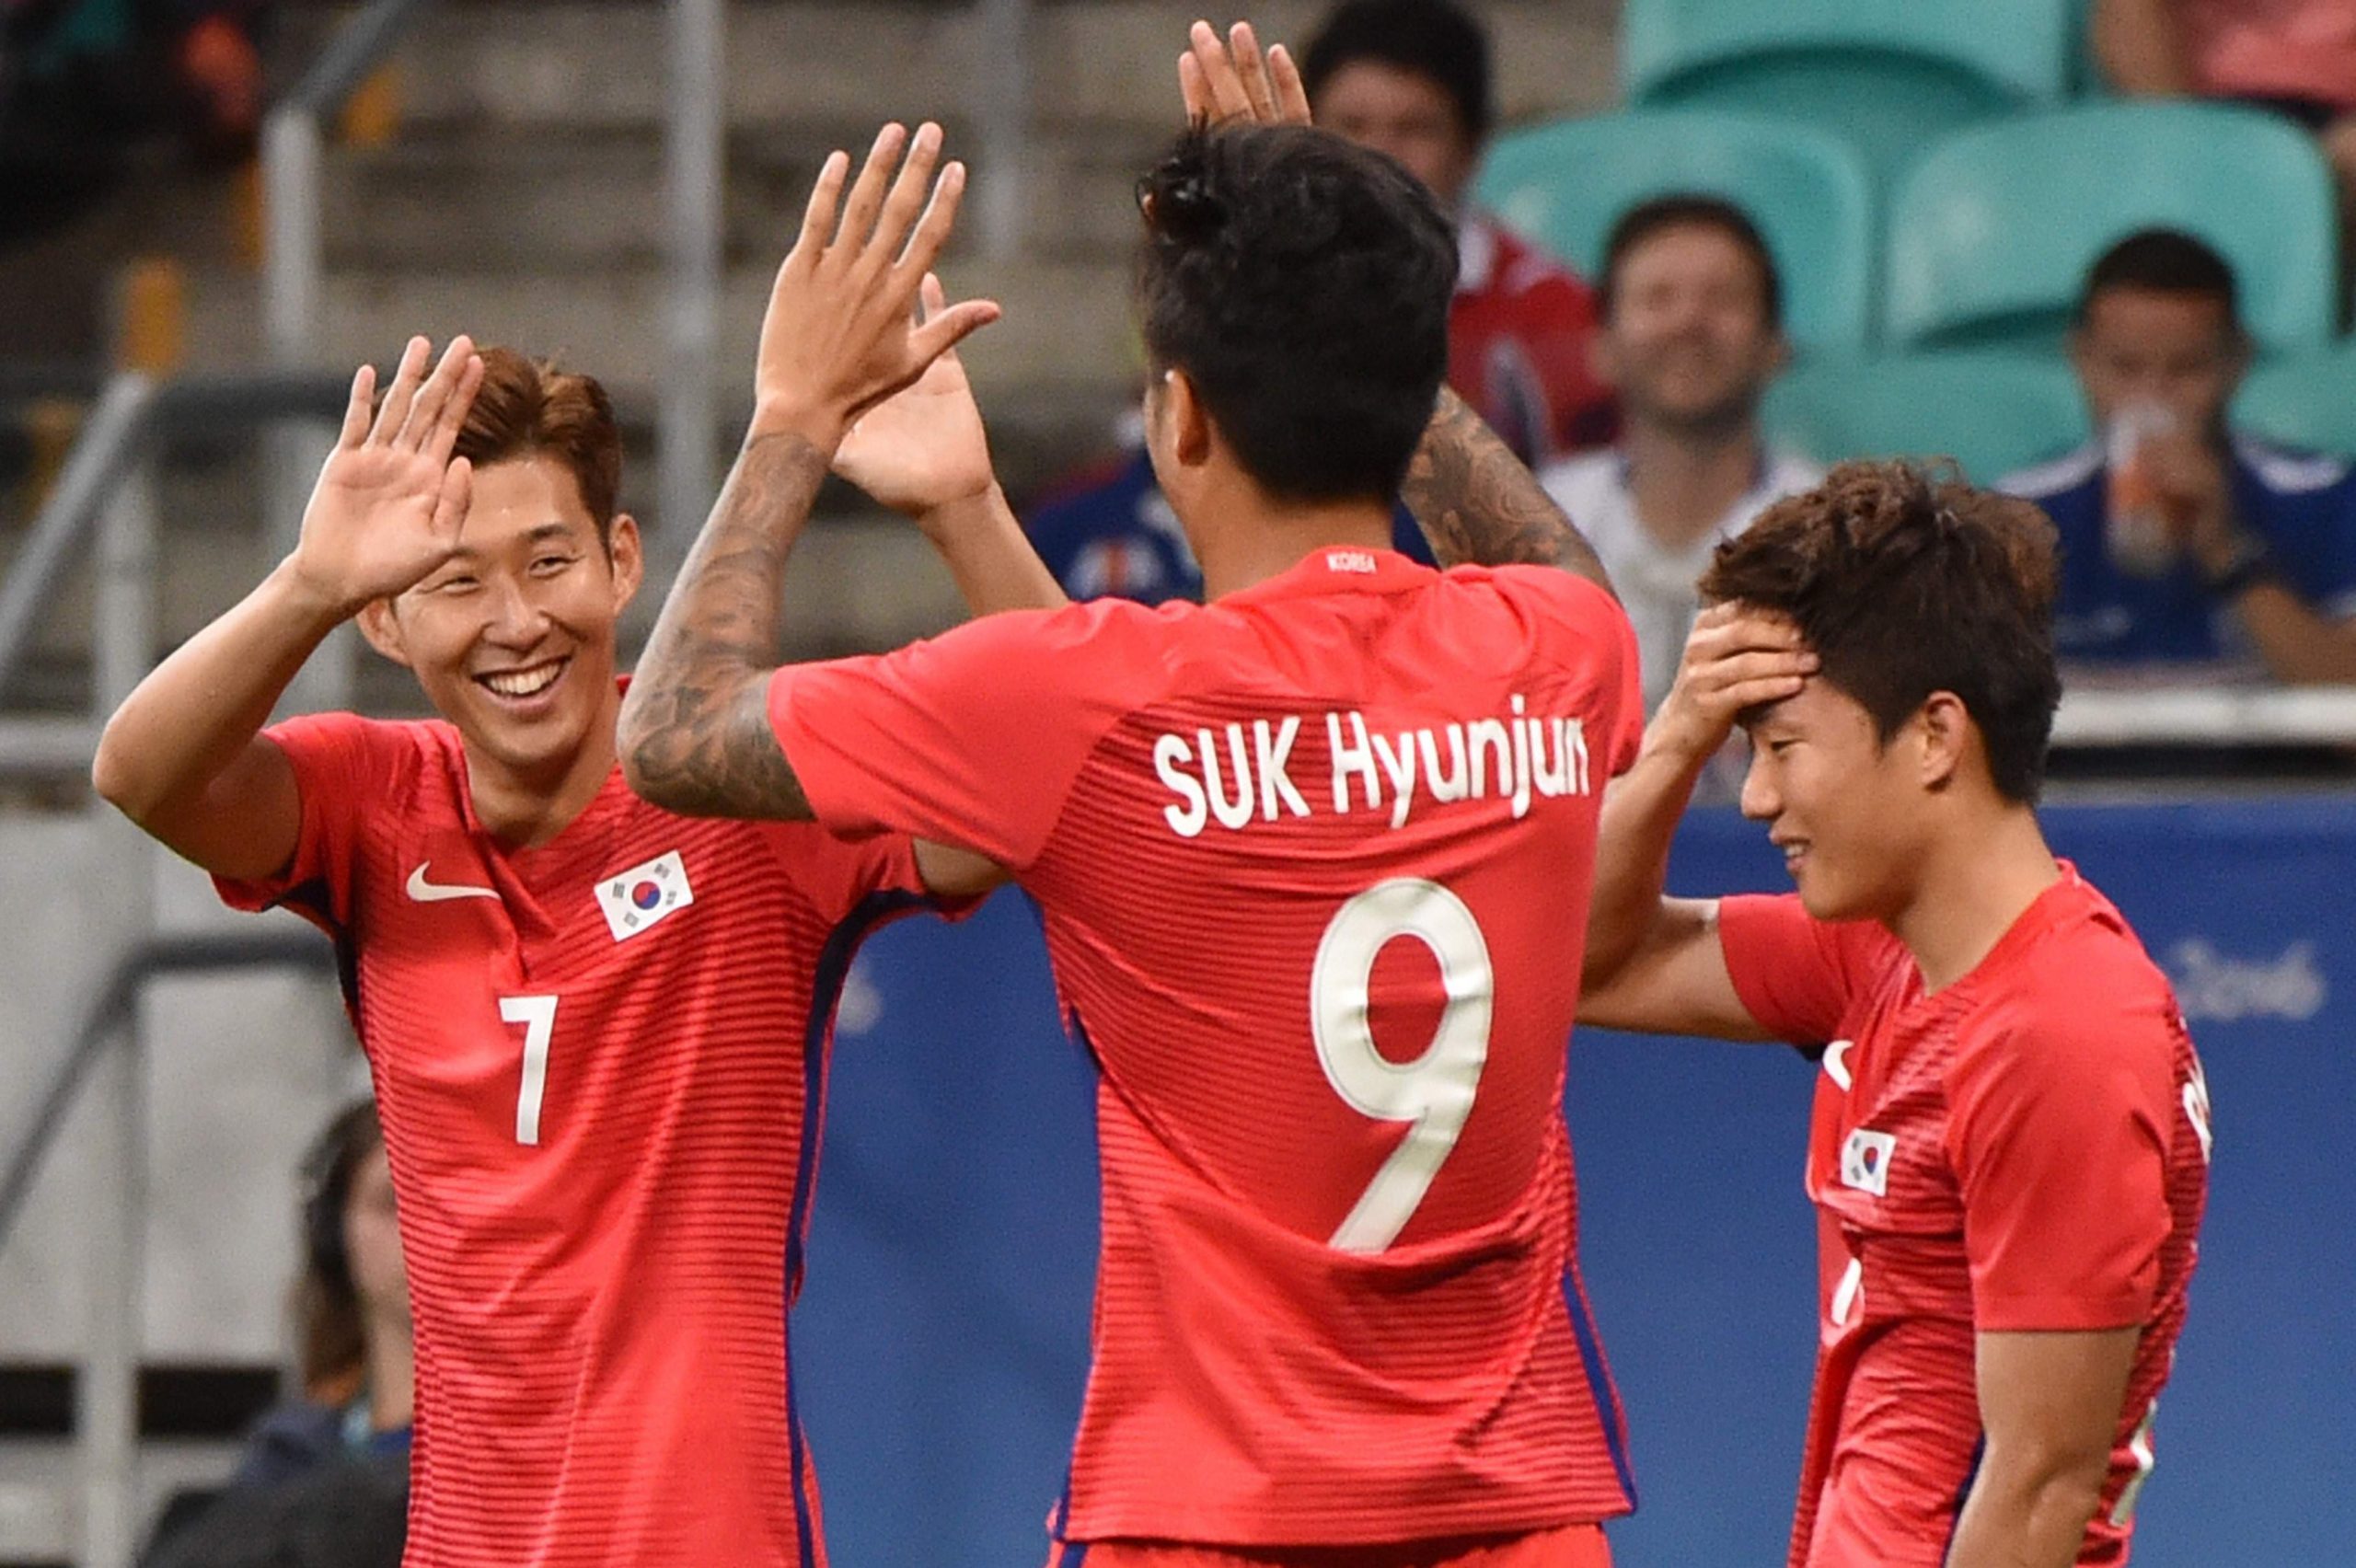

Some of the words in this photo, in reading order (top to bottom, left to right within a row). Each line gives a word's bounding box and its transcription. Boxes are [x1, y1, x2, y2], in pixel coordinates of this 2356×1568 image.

[1326, 552, 1377, 573] KOREA
[1152, 714, 1311, 838] SUK
[1325, 693, 1591, 830] Hyunjun
[498, 995, 559, 1146] 7
[1311, 877, 1494, 1256] 9
